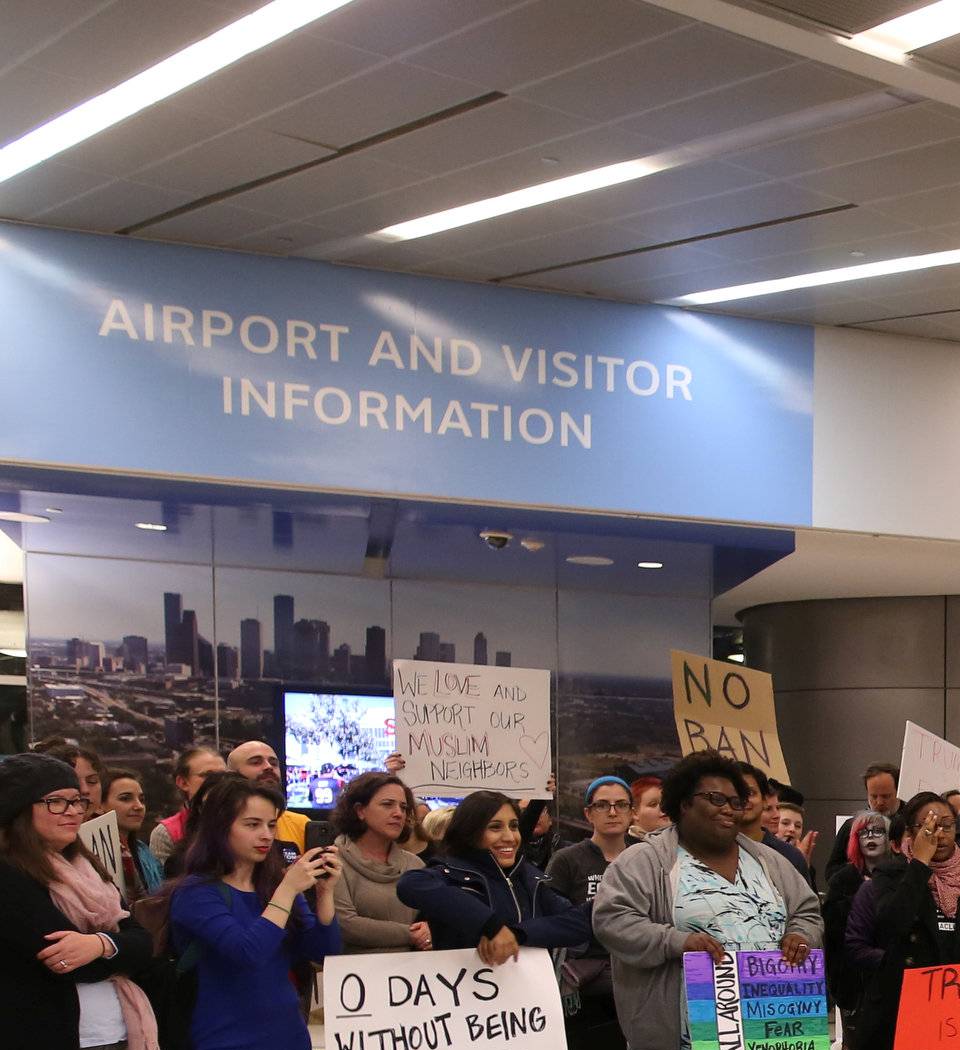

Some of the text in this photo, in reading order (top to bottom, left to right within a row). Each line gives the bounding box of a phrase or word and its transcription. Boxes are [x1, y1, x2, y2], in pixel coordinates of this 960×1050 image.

[98, 299, 693, 401] AIRPORT AND VISITOR
[223, 376, 592, 450] INFORMATION
[398, 668, 527, 701] WE LOVE AND
[683, 660, 751, 710] NO
[402, 700, 526, 734] SUPPORT OUR
[408, 730, 489, 758] MUSLIM
[683, 718, 771, 769] BAN
[430, 759, 529, 783] NEIGHBORS
[388, 967, 500, 1008] DAYS
[714, 952, 741, 1023] AROUND
[742, 981, 824, 999] INEQUALITY
[465, 1006, 547, 1042] BEING
[746, 1000, 823, 1018] MISOGYNY
[939, 1017, 958, 1041] IS
